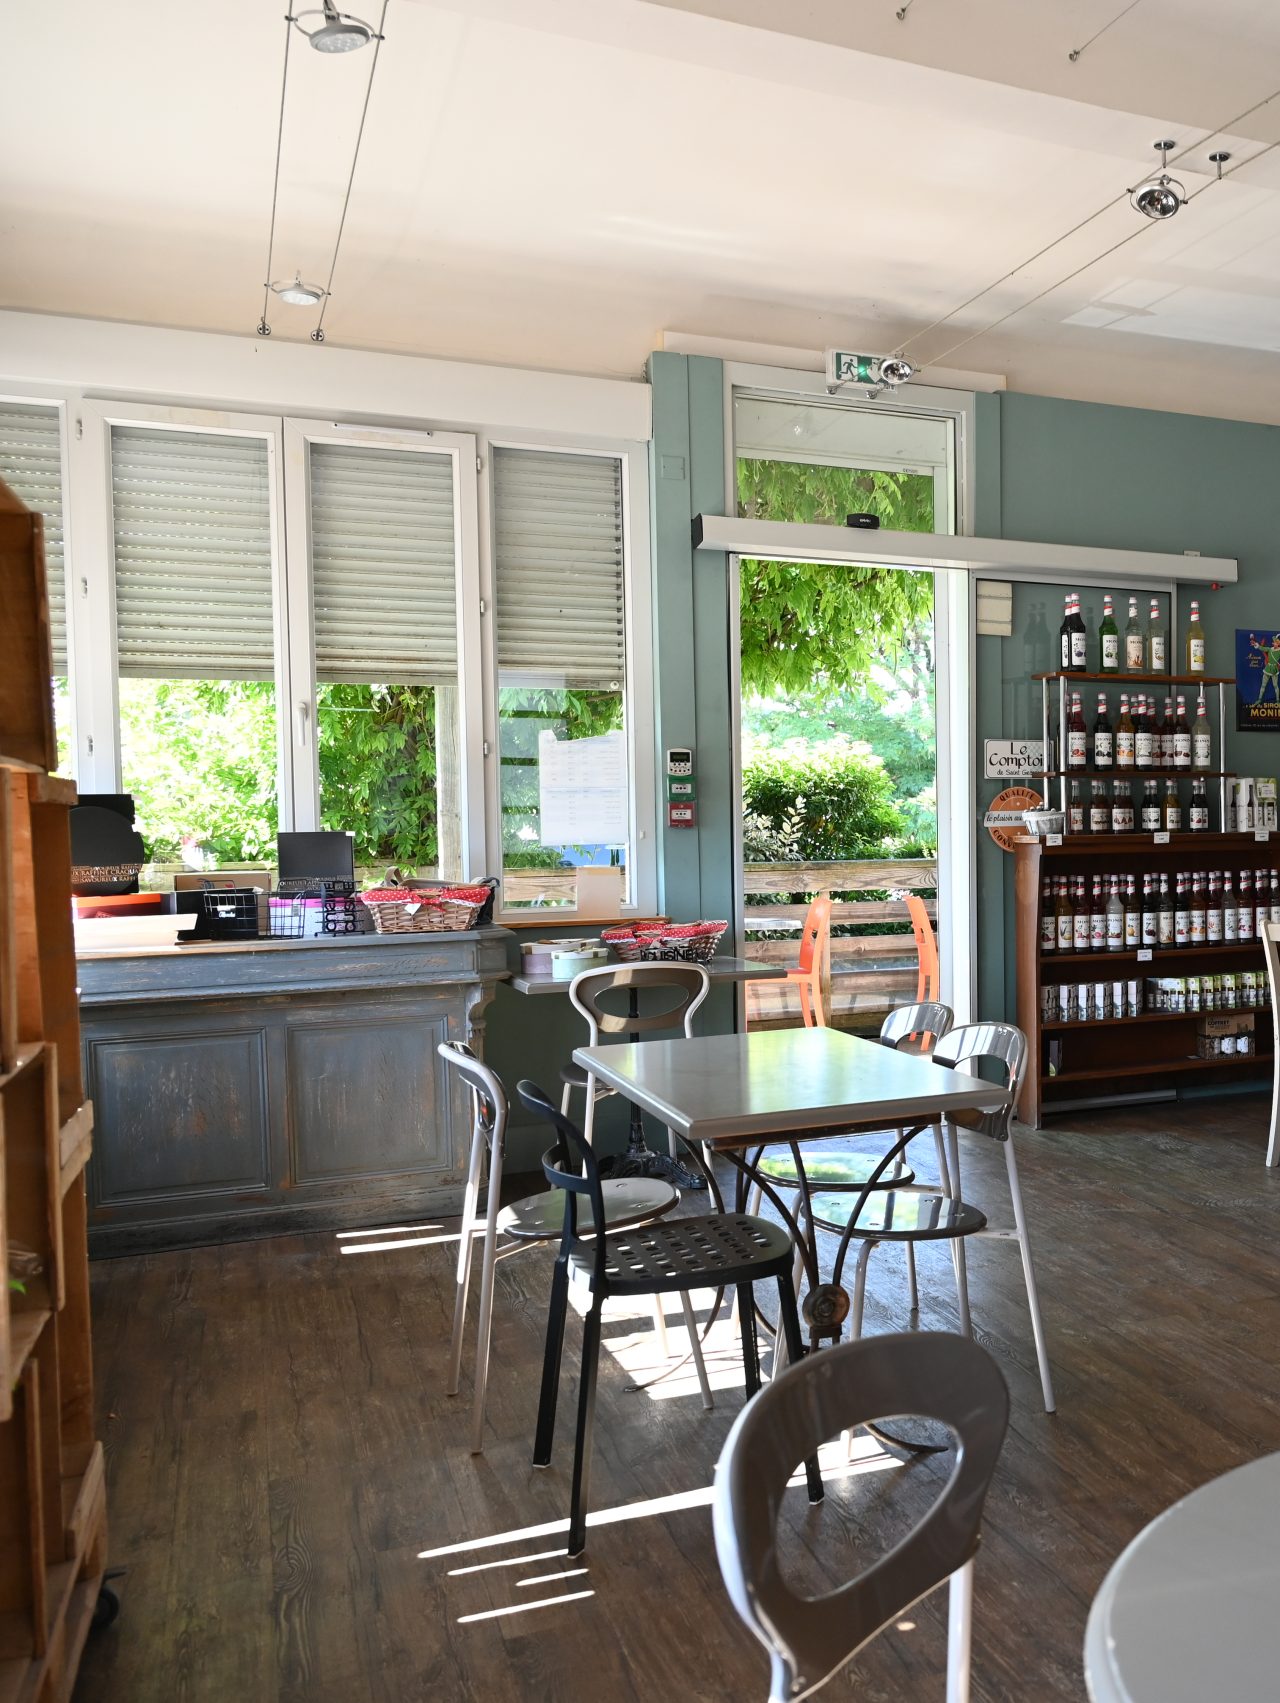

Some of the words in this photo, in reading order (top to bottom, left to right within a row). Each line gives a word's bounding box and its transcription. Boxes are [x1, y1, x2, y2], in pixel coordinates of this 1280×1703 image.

[1010, 742, 1028, 755] Le
[989, 753, 1043, 770] Comptoi
[986, 814, 993, 822] le
[993, 813, 1013, 825] plaisir
